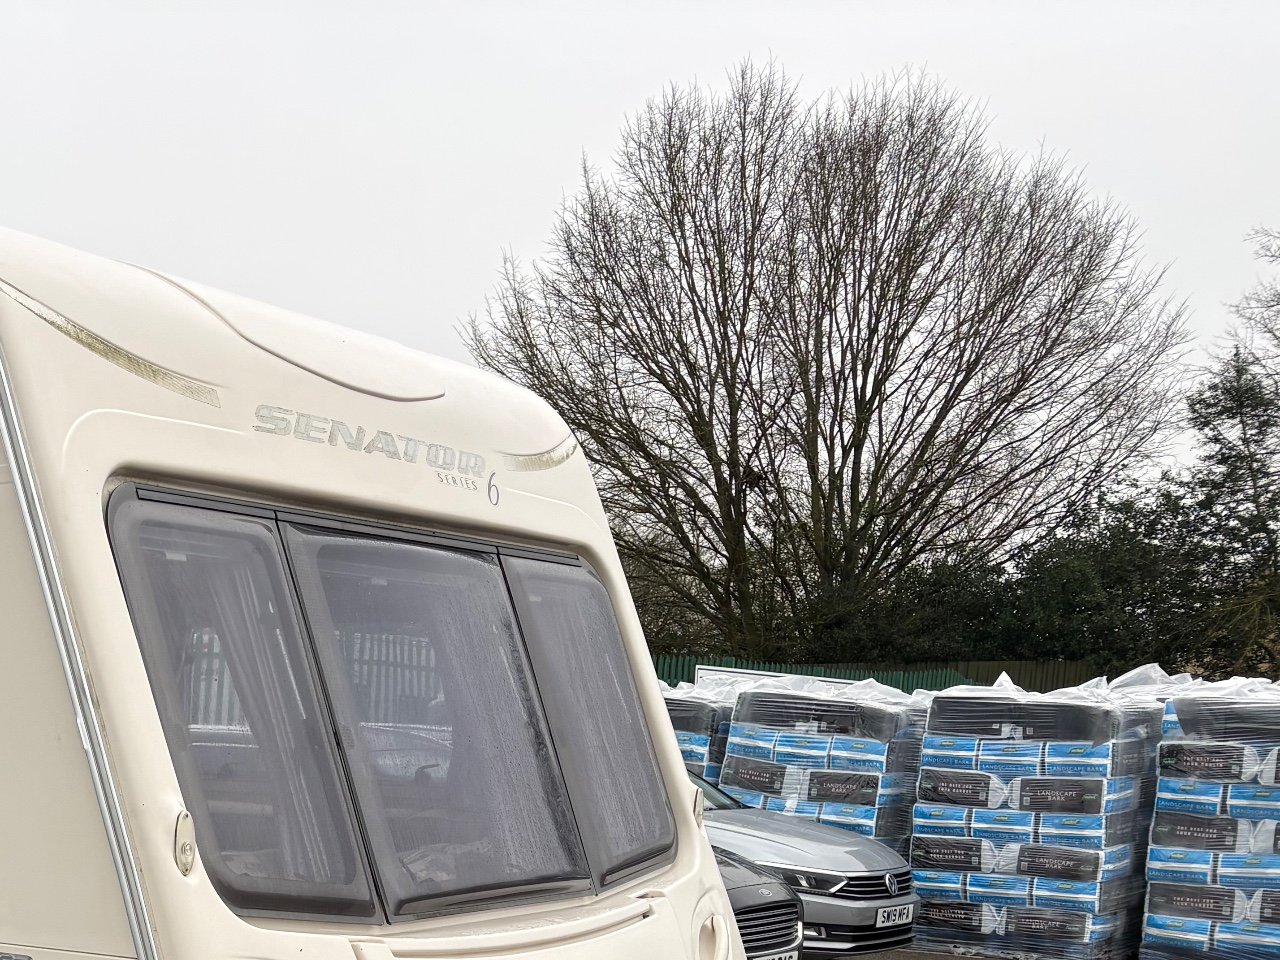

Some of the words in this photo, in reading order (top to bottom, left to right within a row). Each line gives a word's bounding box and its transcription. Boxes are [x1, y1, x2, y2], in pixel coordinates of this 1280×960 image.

[253, 404, 486, 478] SENATOR
[437, 472, 478, 491] SERIES
[488, 471, 500, 506] 6
[1037, 790, 1077, 798] LANDSCAPE
